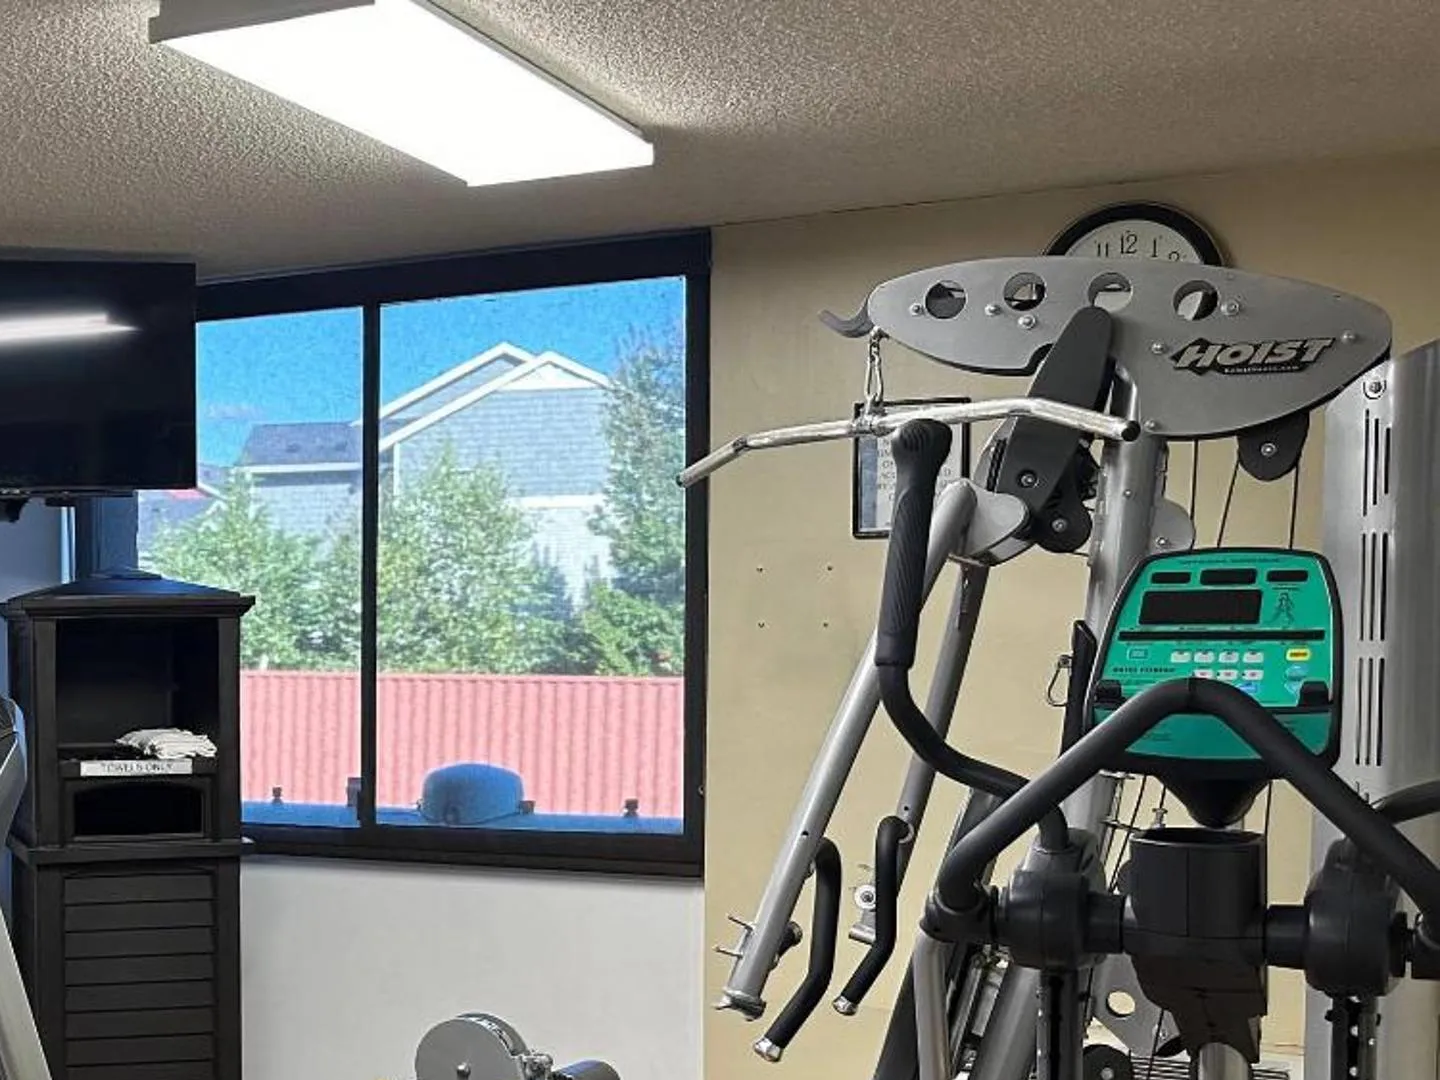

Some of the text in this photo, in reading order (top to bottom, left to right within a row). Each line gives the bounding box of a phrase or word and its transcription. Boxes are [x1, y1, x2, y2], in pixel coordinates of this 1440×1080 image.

[1097, 242, 1109, 258] 11
[1120, 232, 1138, 254] 12
[1150, 238, 1158, 257] 1
[1175, 338, 1335, 368] HOIST
